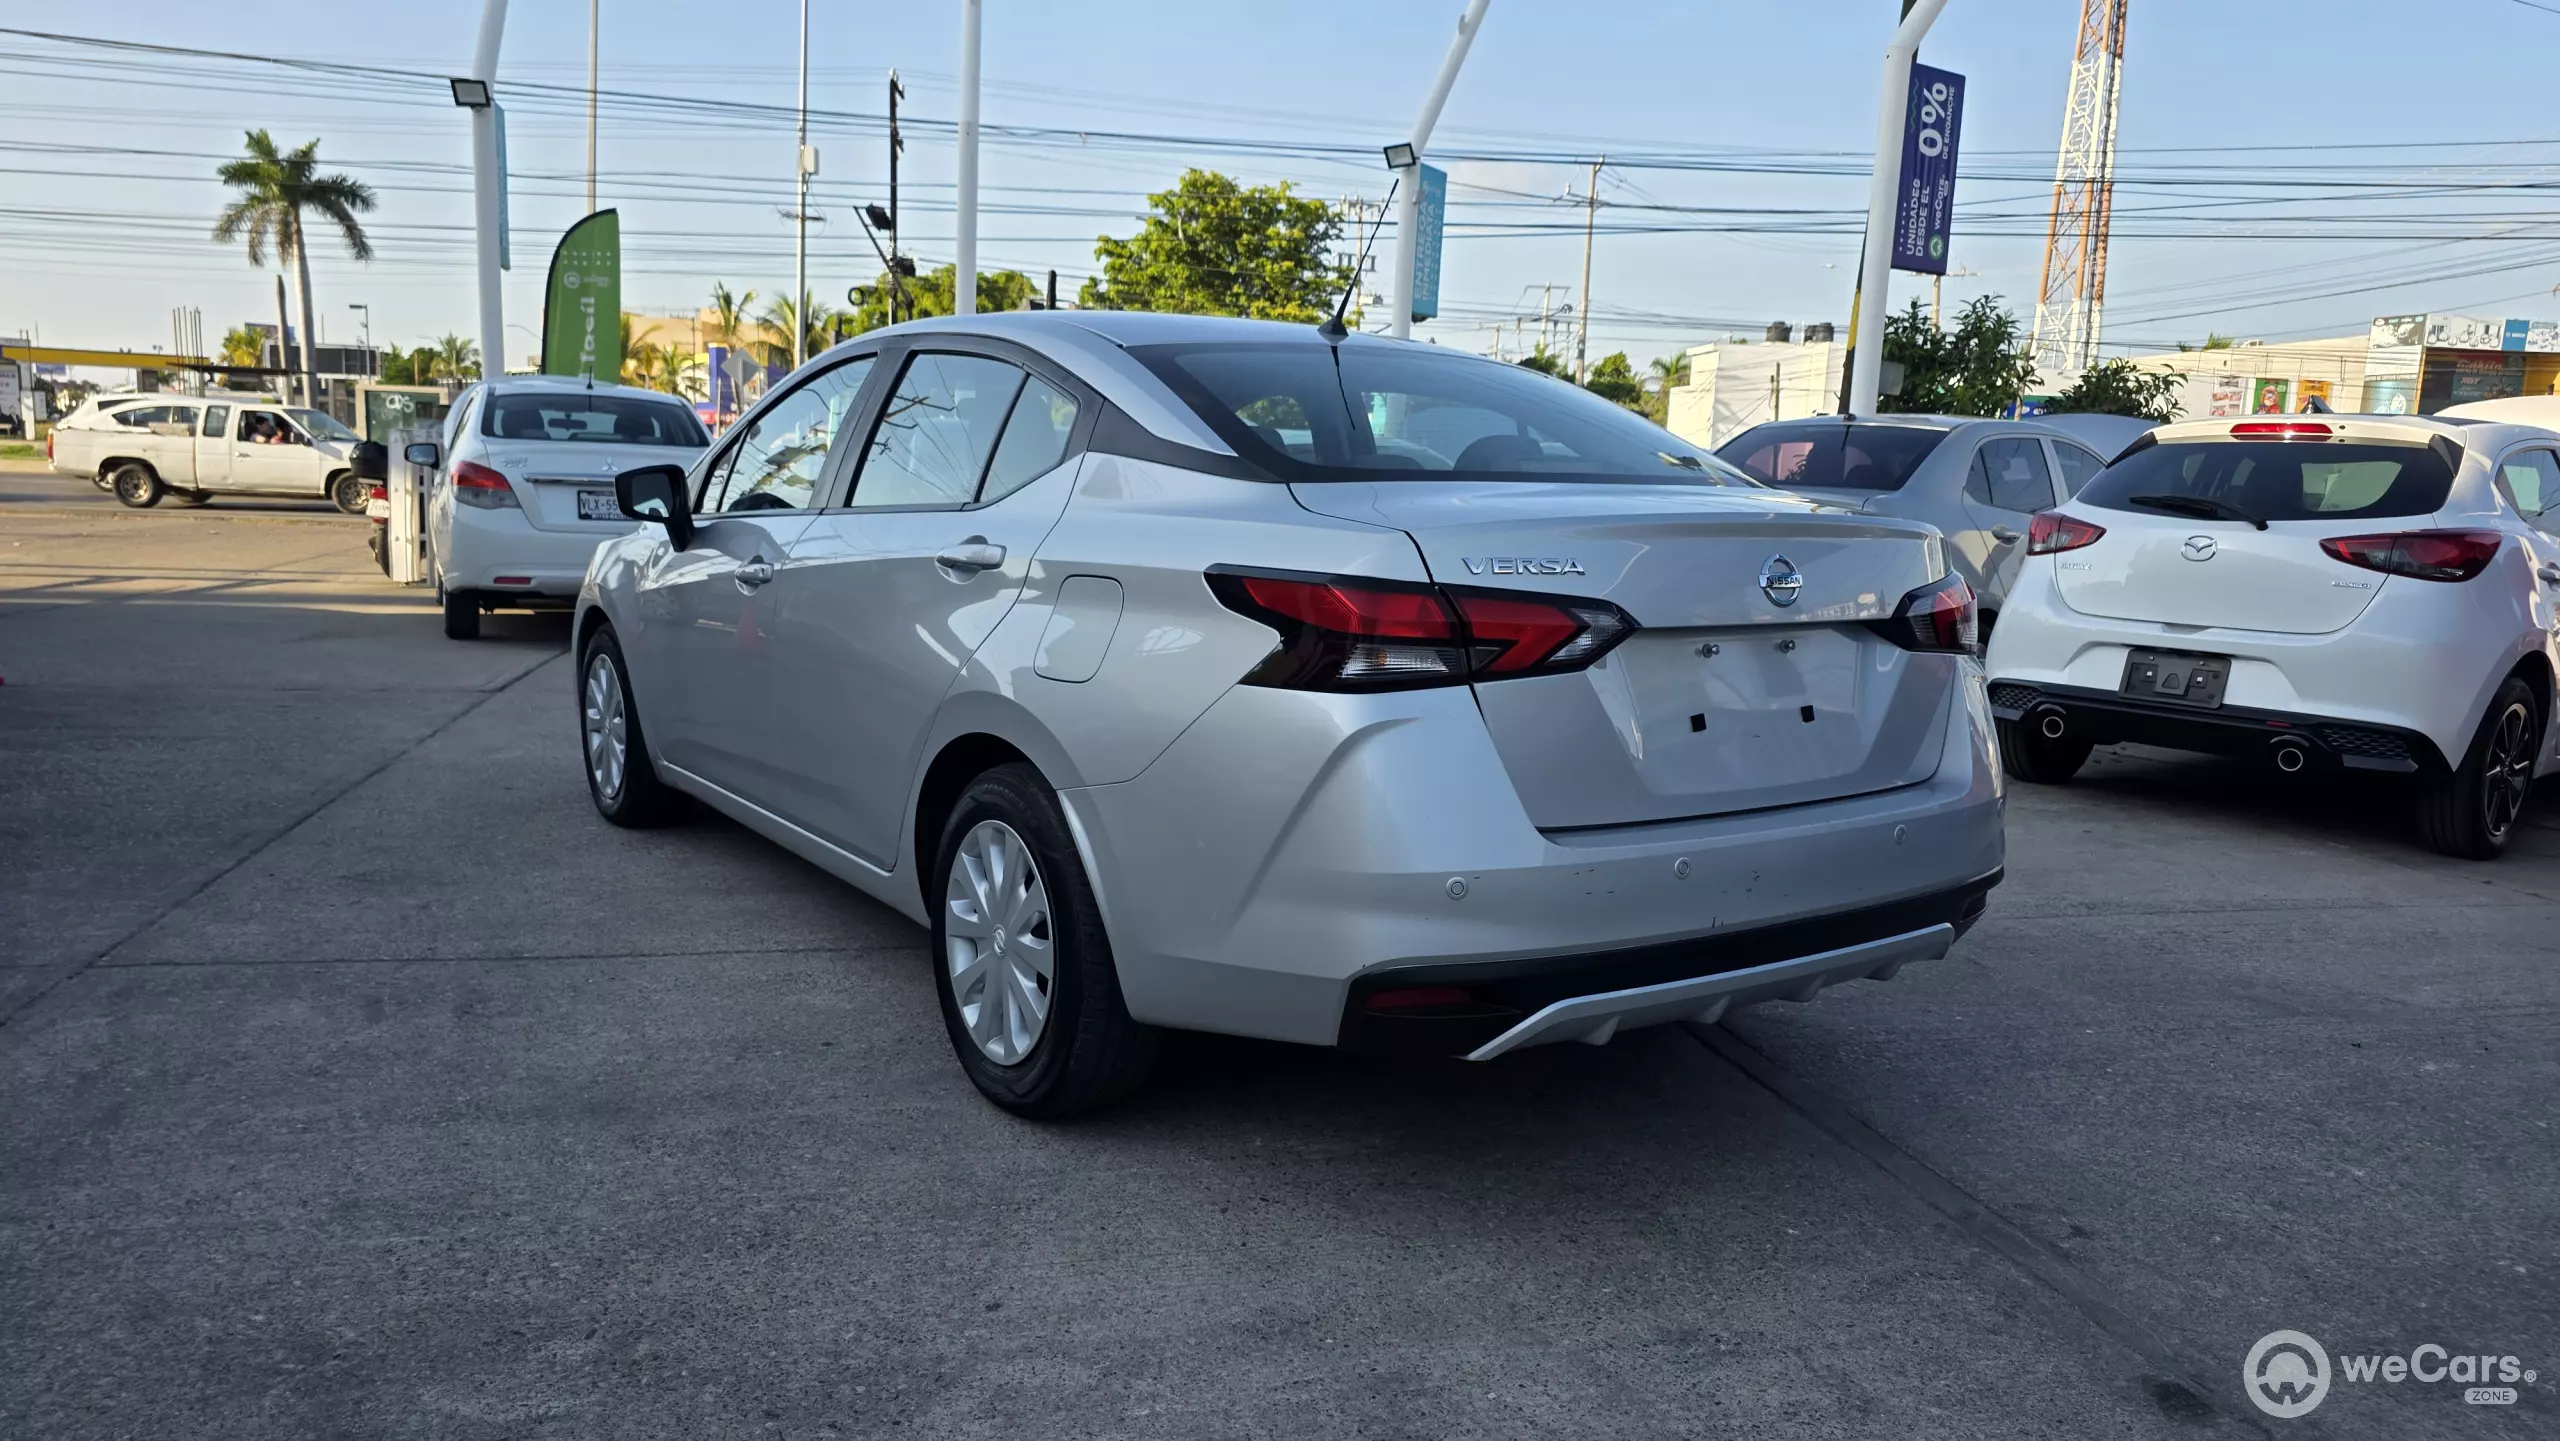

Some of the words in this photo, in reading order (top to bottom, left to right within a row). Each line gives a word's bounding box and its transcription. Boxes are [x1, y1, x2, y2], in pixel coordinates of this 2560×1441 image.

[1918, 82, 1948, 157] 0%
[1944, 85, 1955, 144] ENGANCHE
[1942, 144, 1950, 160] DE
[1906, 178, 1921, 255] UNIDADES
[1920, 185, 1930, 204] EL
[1413, 201, 1428, 300] ENTREGA
[1421, 204, 1436, 301] INMEDIATA
[1915, 206, 1928, 257] DESDE
[1462, 556, 1587, 576] VERSA
[1766, 576, 1801, 586] NISSAN
